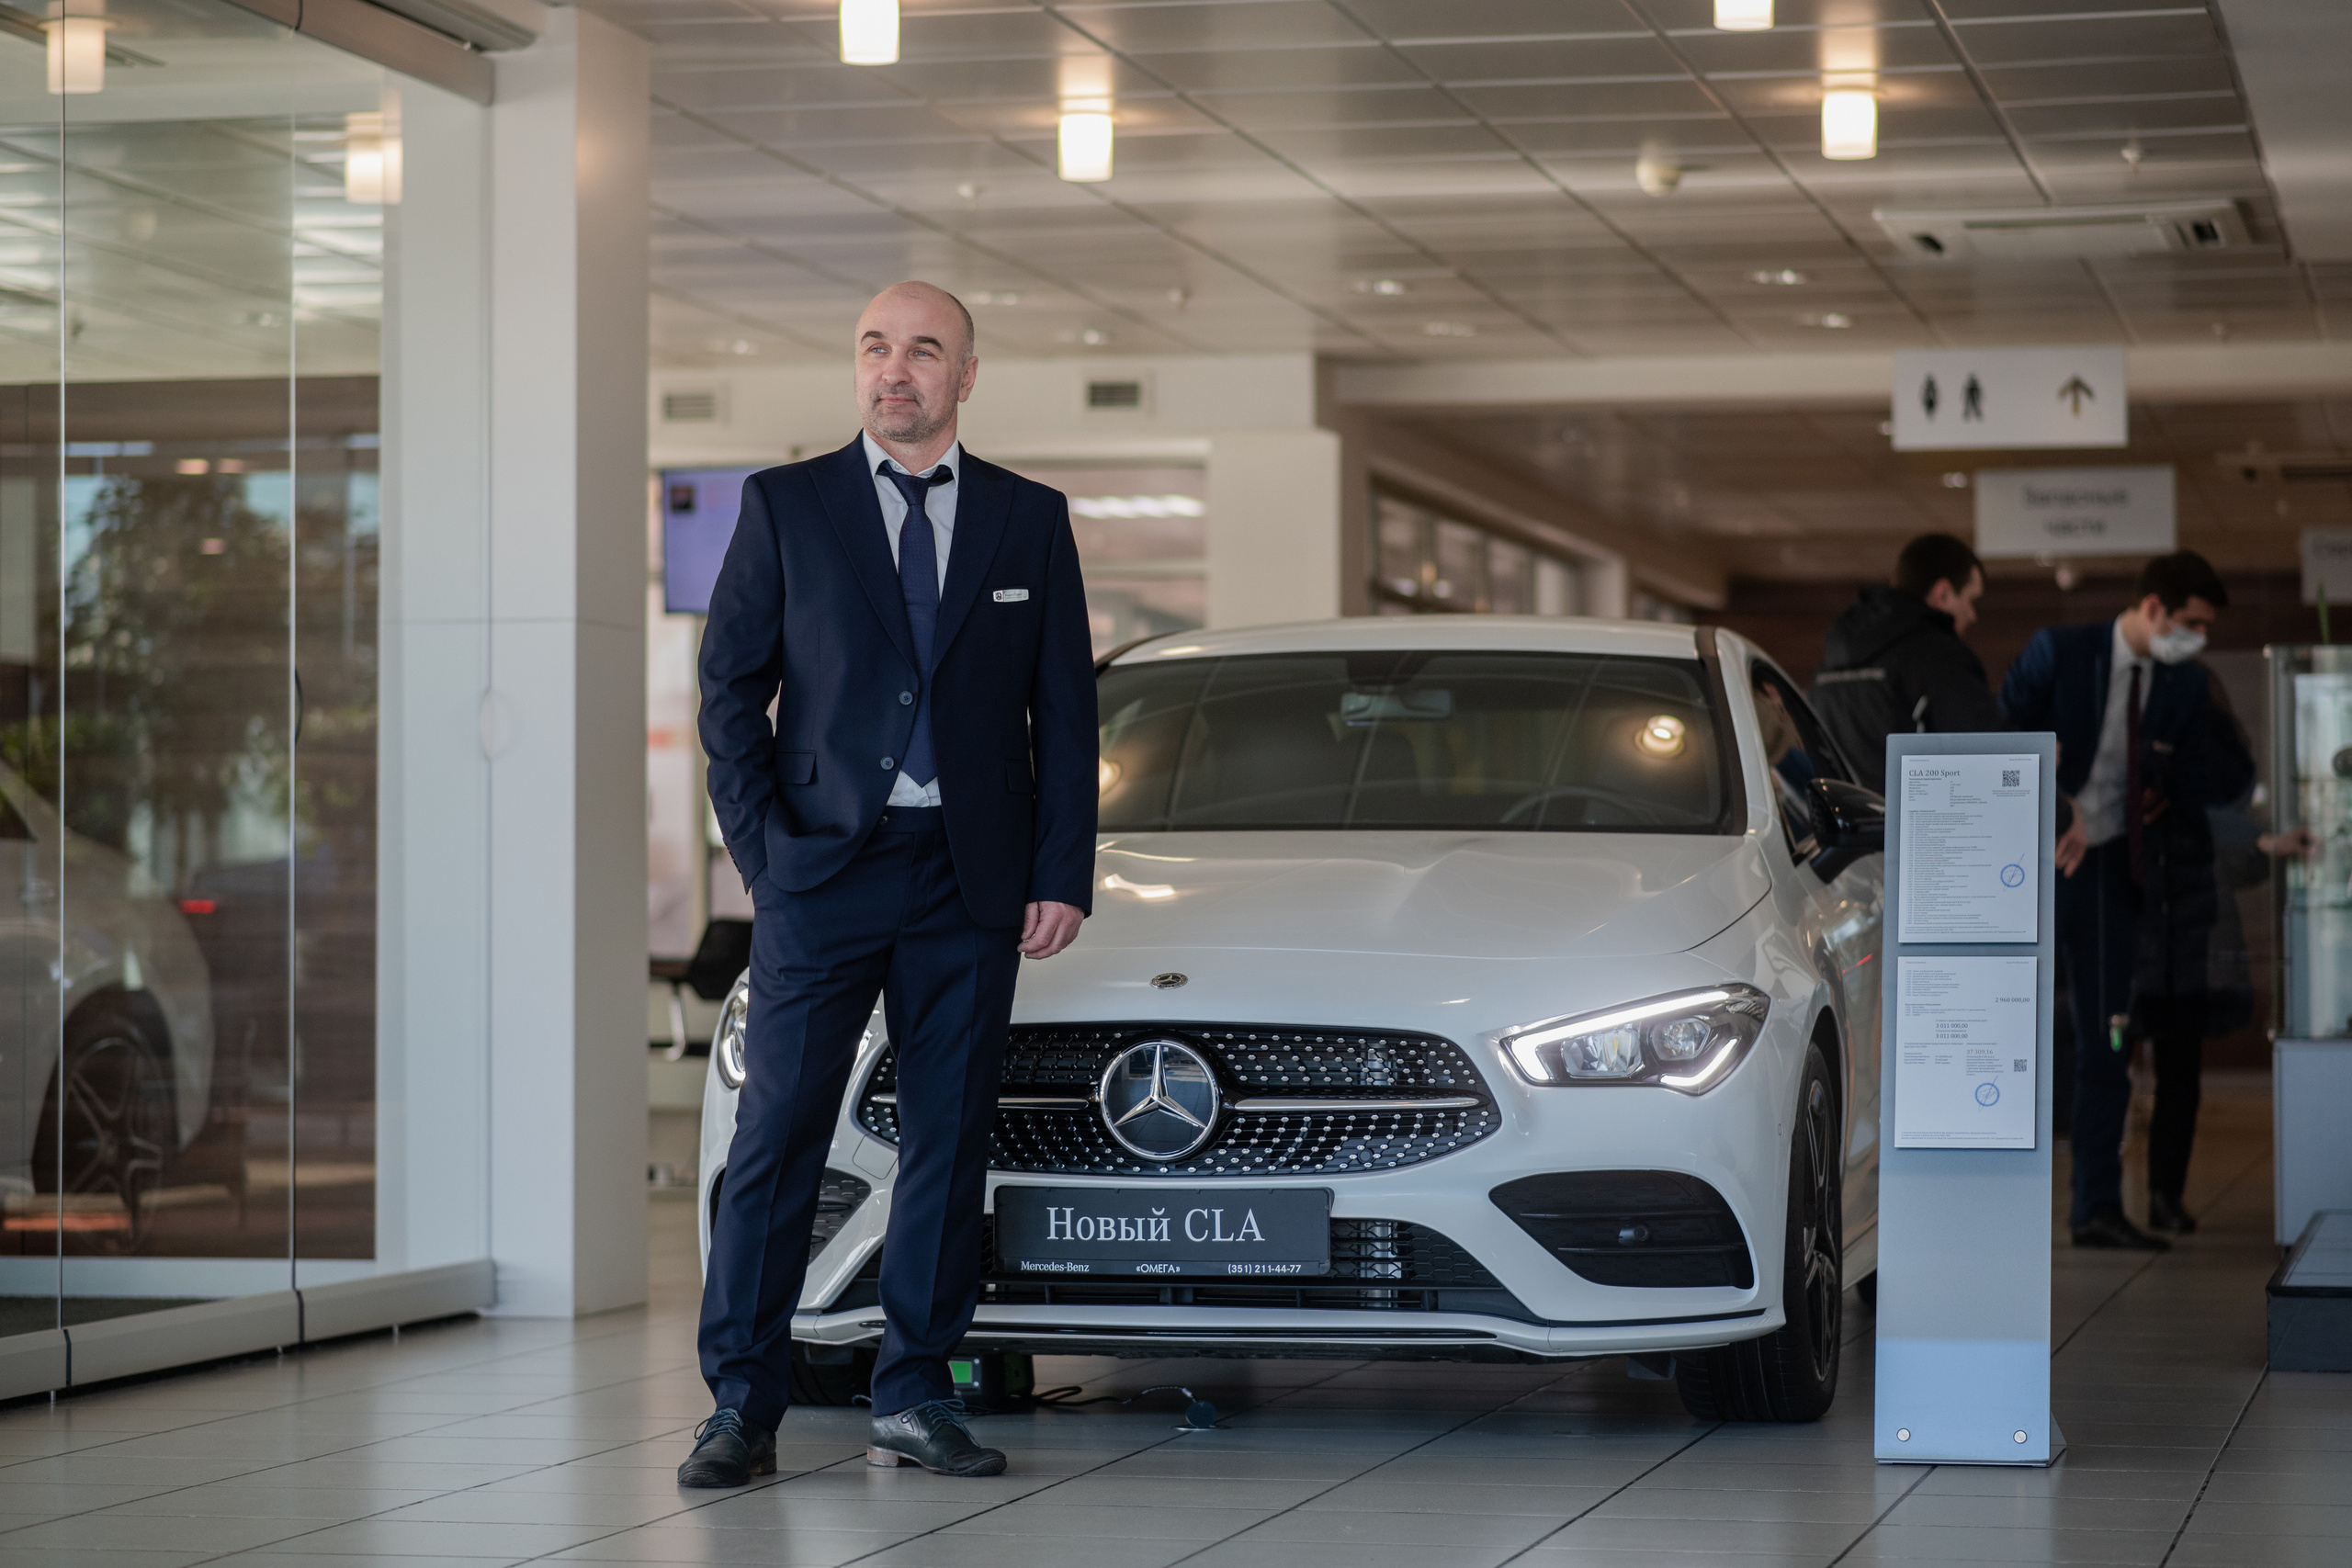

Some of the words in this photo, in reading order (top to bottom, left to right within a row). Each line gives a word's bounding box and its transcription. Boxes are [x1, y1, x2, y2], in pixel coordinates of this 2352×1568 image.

[1940, 770, 1961, 778] Sport
[1046, 1206, 1170, 1243] Новый
[1184, 1207, 1265, 1243] CLA
[1020, 1260, 1090, 1273] Mercedes-Benz
[1136, 1263, 1181, 1274] «ОМЕГА»
[1227, 1263, 1252, 1275] (351)
[1254, 1264, 1302, 1274] 211-44-77
